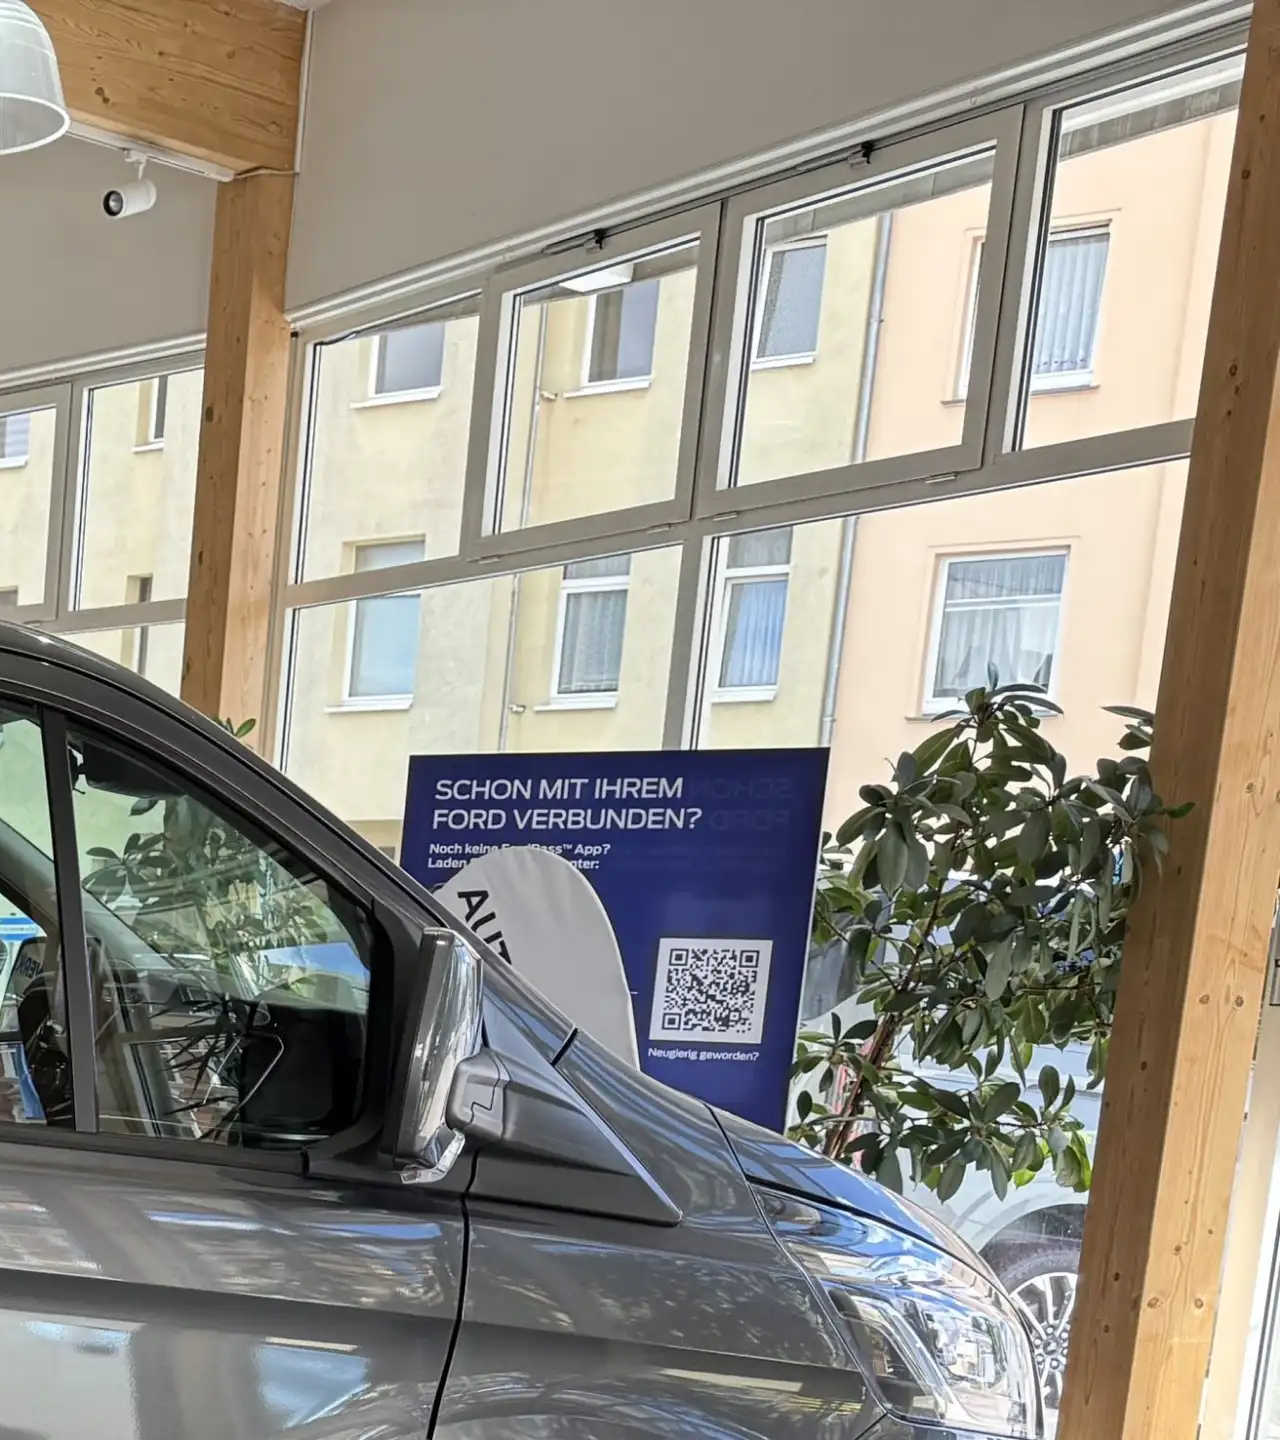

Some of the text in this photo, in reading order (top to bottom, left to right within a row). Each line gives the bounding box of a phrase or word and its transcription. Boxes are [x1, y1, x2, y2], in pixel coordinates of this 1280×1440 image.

[434, 777, 684, 800] SCHON MIT IHREM
[432, 808, 702, 830] FORD VERBUNDEN?
[429, 843, 462, 854] Noch
[574, 843, 611, 856] App?
[427, 857, 467, 868] Laden
[647, 1047, 760, 1061] Neugierig geworden?
